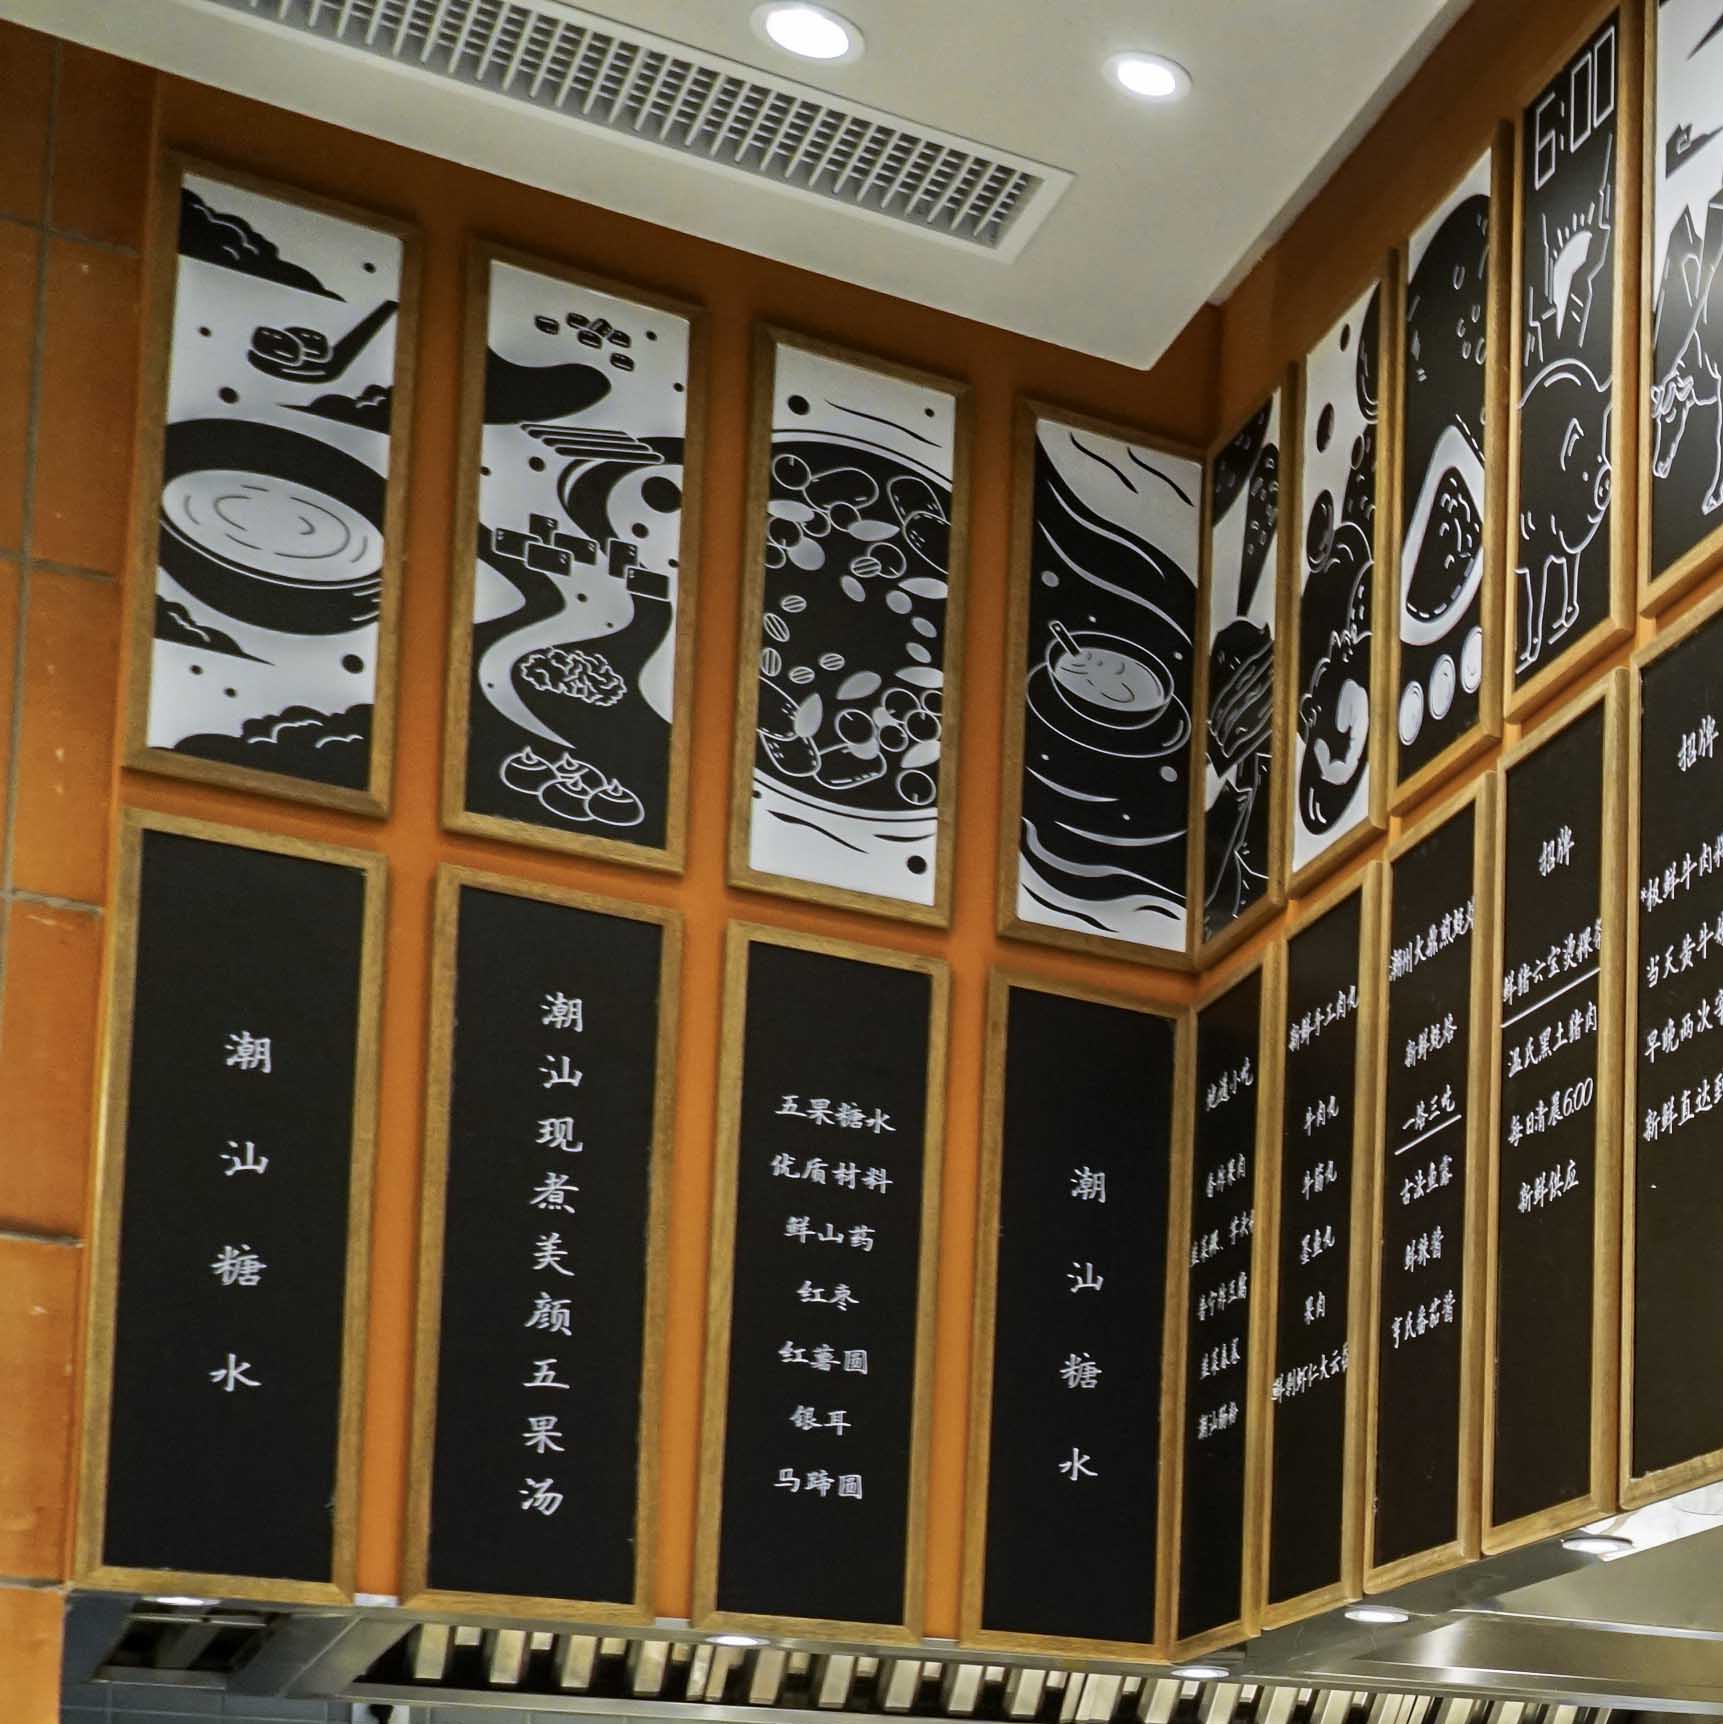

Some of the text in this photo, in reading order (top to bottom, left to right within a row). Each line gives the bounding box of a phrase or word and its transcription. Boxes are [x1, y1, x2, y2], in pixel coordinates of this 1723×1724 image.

[1539, 825, 1575, 877] 招牌
[775, 1095, 896, 1134] 五果糖水
[769, 1153, 893, 1194] 优质材料
[1517, 1159, 1579, 1213] 新鲜供应
[211, 1031, 273, 1394] 潮汕糖水
[783, 1216, 876, 1252] 鲜山药
[519, 993, 586, 1517] 潮汕现煮美颜五果汤
[797, 1280, 860, 1311] 红枣
[1057, 1166, 1106, 1481] 潮汕糖水
[790, 1405, 852, 1436] 银耳
